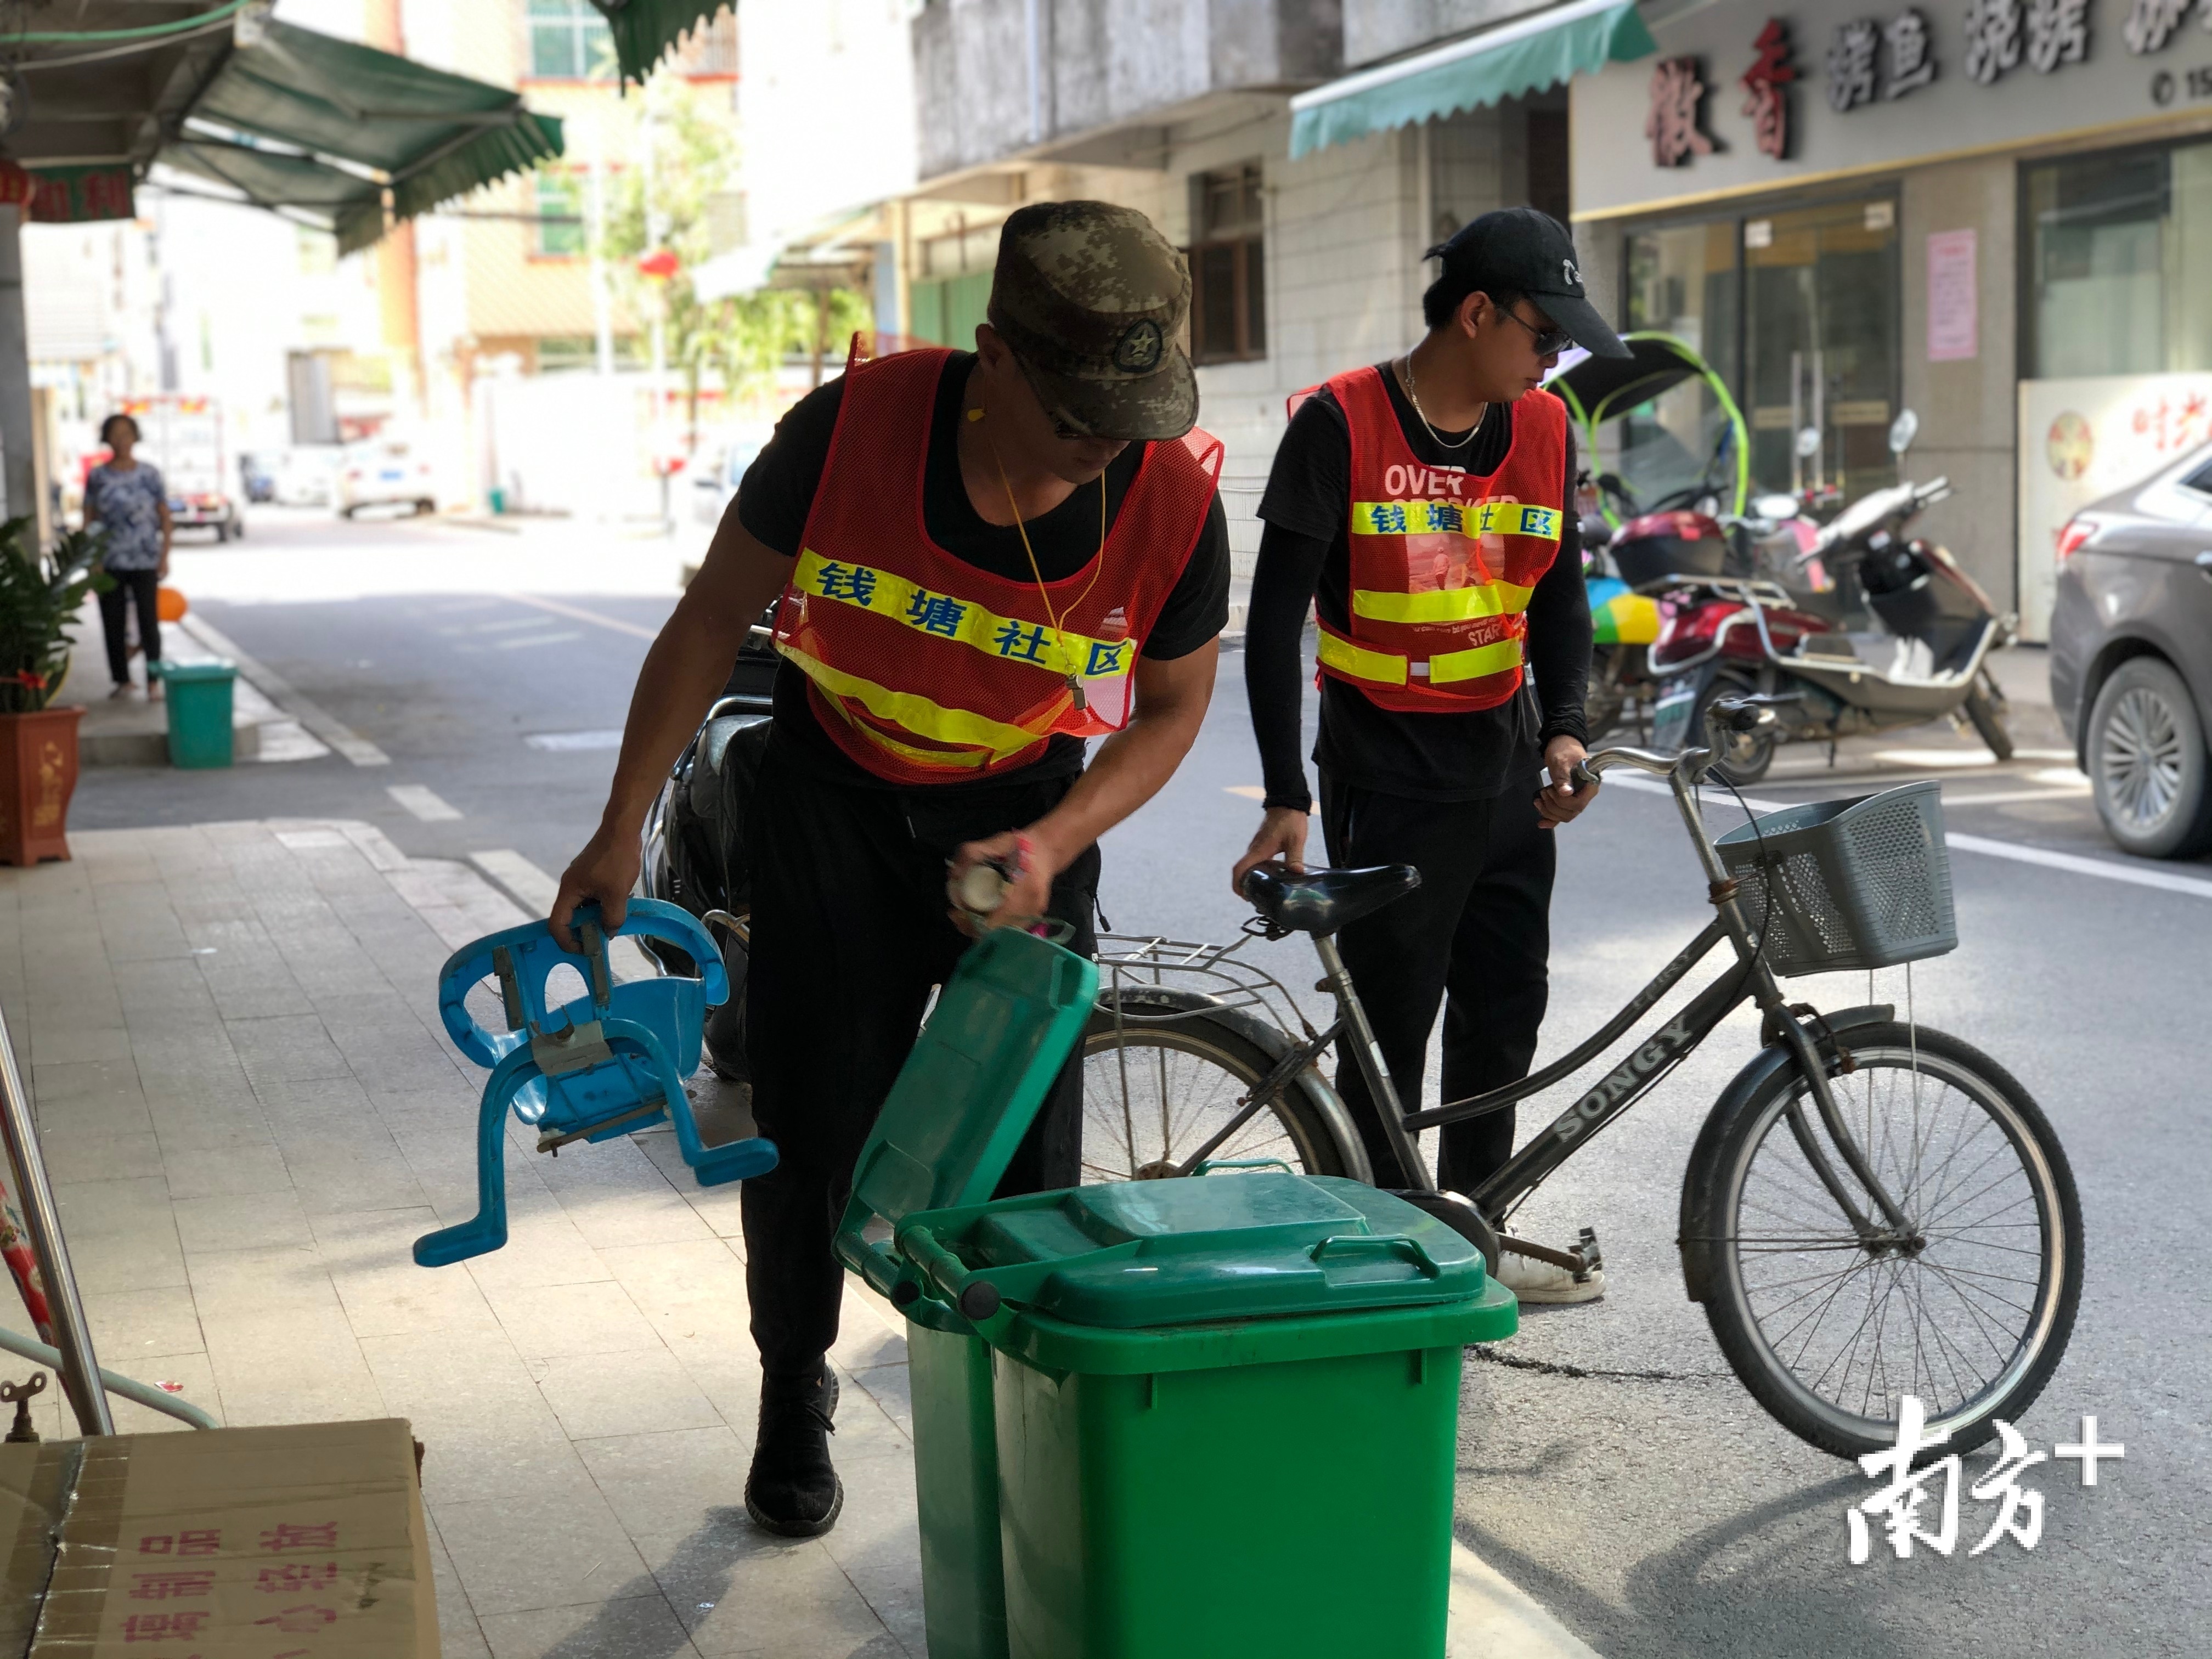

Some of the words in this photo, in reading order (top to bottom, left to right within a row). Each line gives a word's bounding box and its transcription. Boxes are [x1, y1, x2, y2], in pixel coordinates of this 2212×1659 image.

[1385, 464, 1466, 495] OVER
[817, 561, 1127, 676] 钱塘社区
[1553, 1015, 1693, 1143] SONGY
[120, 1529, 222, 1659] 璃制品
[253, 1521, 338, 1659] 心轻放
